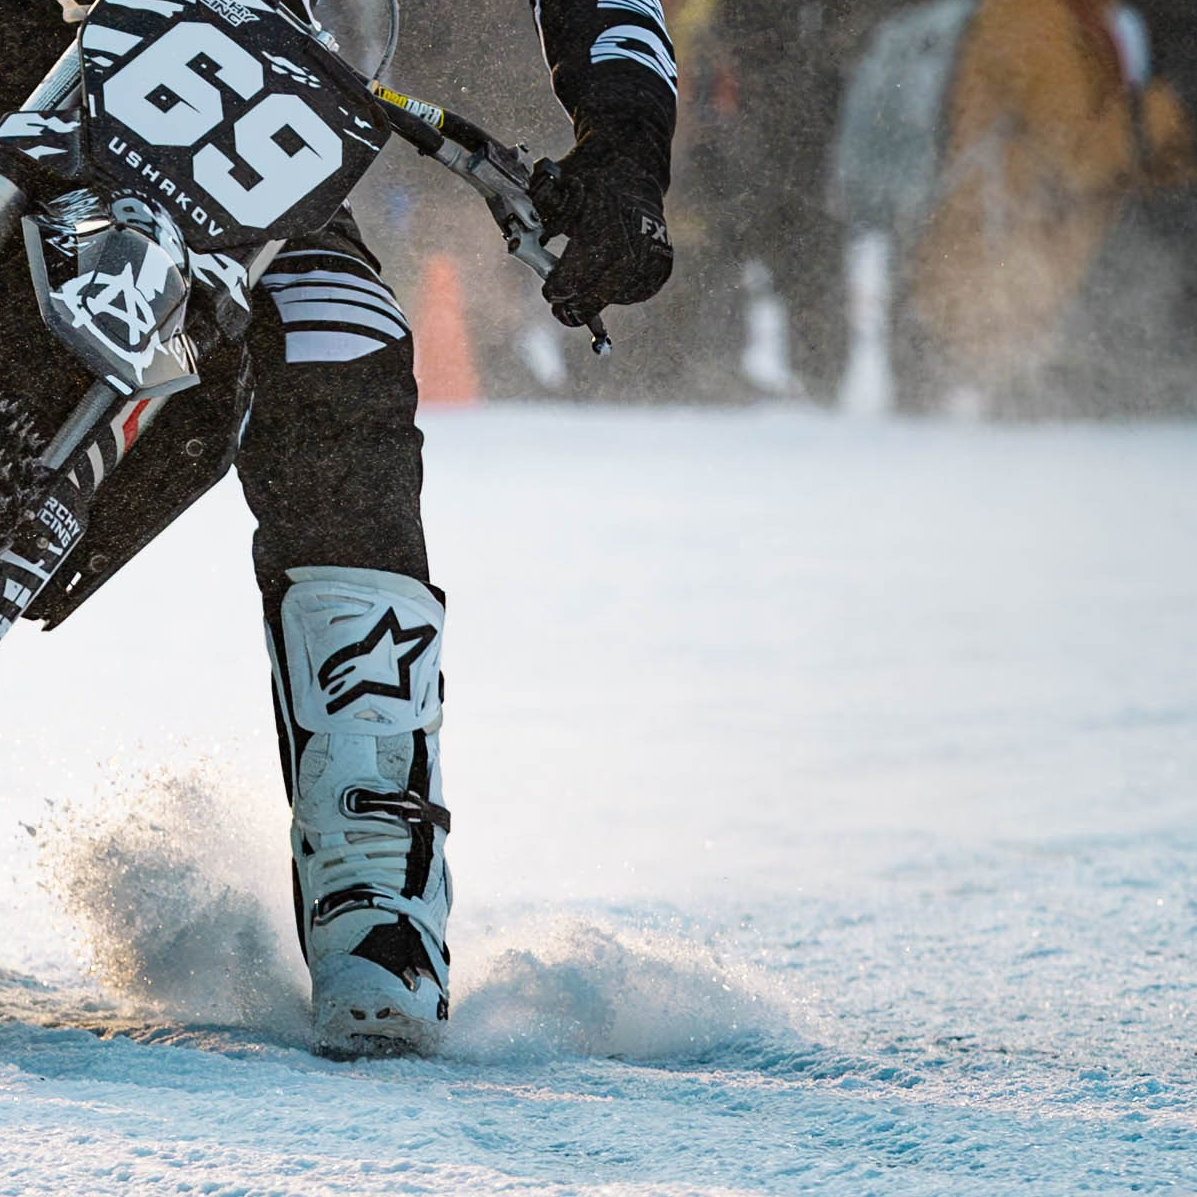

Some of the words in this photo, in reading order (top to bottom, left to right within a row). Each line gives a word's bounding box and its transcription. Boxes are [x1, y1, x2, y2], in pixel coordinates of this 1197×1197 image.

[103, 21, 343, 229] 69
[108, 135, 224, 238] USHAKOV
[640, 215, 671, 246] FX
[36, 507, 72, 549] CING
[44, 496, 81, 537] RCHY
